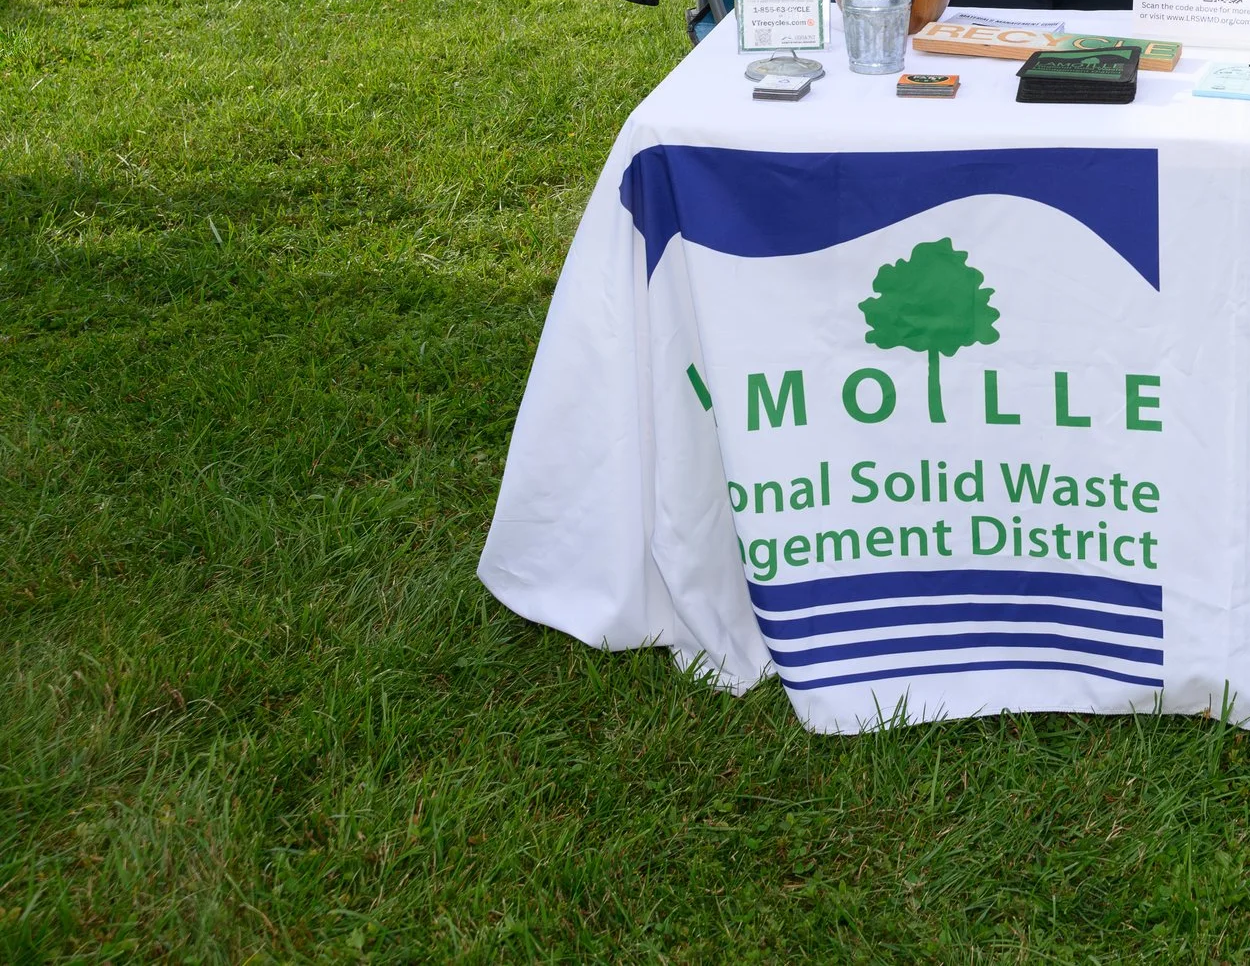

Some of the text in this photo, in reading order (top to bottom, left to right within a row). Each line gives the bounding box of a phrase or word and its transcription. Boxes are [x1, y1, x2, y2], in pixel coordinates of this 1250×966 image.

[1141, 1, 1160, 10] Scan
[1161, 2, 1174, 10] the
[1175, 3, 1194, 11] code
[1195, 4, 1218, 13] above
[1219, 6, 1230, 14] for
[1139, 12, 1148, 20] or
[1149, 13, 1165, 21] visit
[751, 19, 807, 28] VTrecycles.com
[850, 459, 985, 504] Solid
[999, 462, 1161, 514] Waste
[738, 515, 1159, 582] gement District
